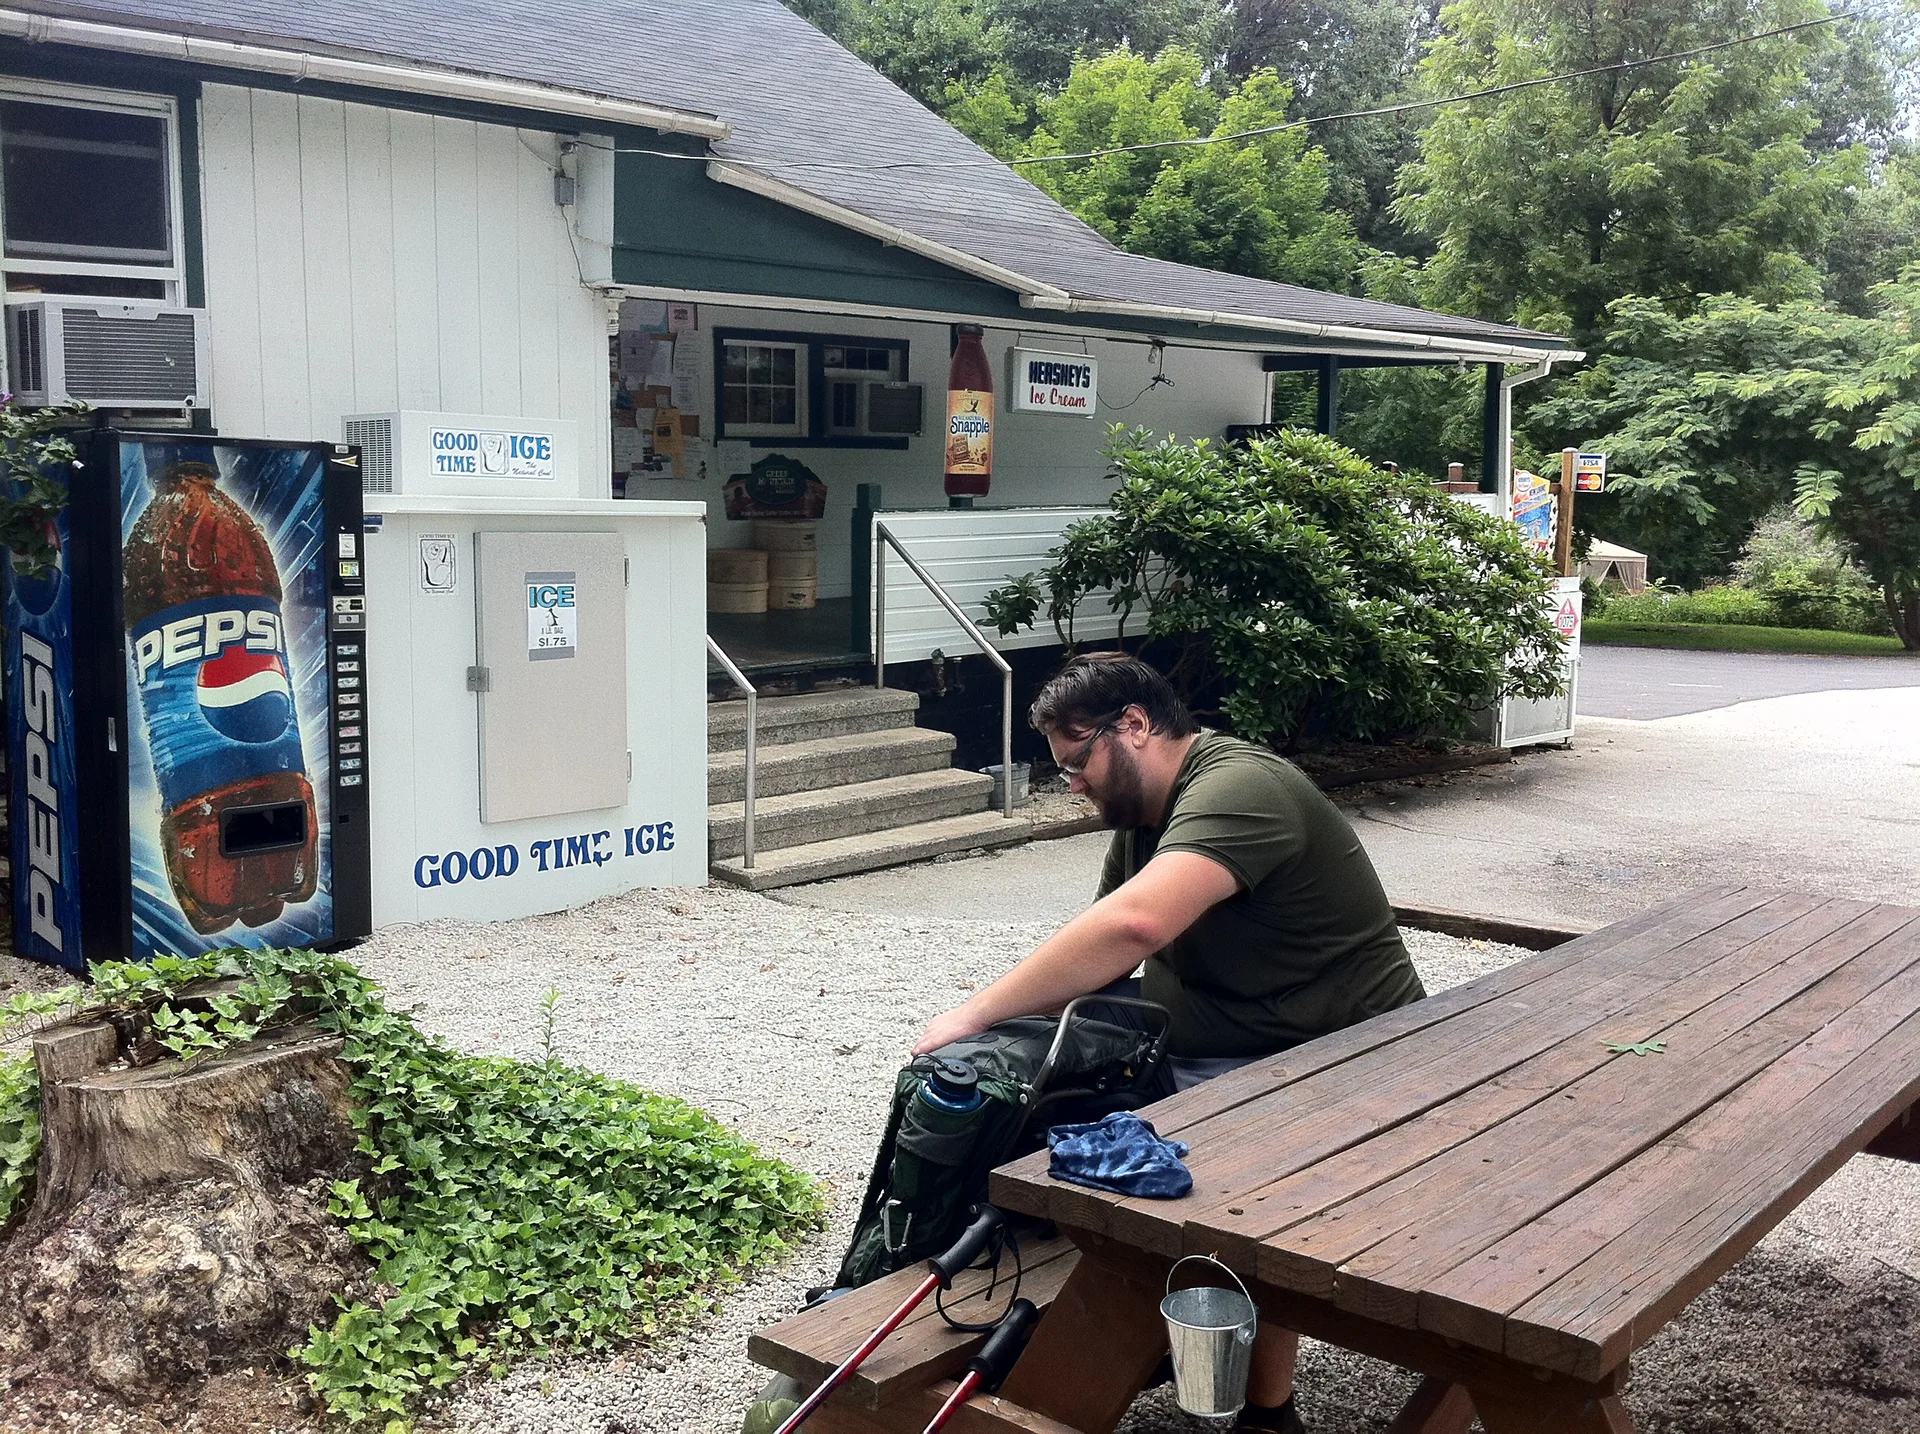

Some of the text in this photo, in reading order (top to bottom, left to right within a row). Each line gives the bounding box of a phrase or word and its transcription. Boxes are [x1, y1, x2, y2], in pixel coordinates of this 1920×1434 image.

[1028, 361, 1091, 388] HERSHEY'S
[1030, 385, 1087, 407] Ice Cream
[950, 416, 990, 438] Snapple
[433, 431, 551, 460] GOOD ICE
[436, 454, 476, 473] TIME
[529, 585, 575, 608] ICE
[135, 609, 283, 685] PEPSI
[538, 637, 567, 647] $1.75
[22, 631, 63, 952] PEPSI
[414, 821, 675, 888] GOOD TIME ICE
